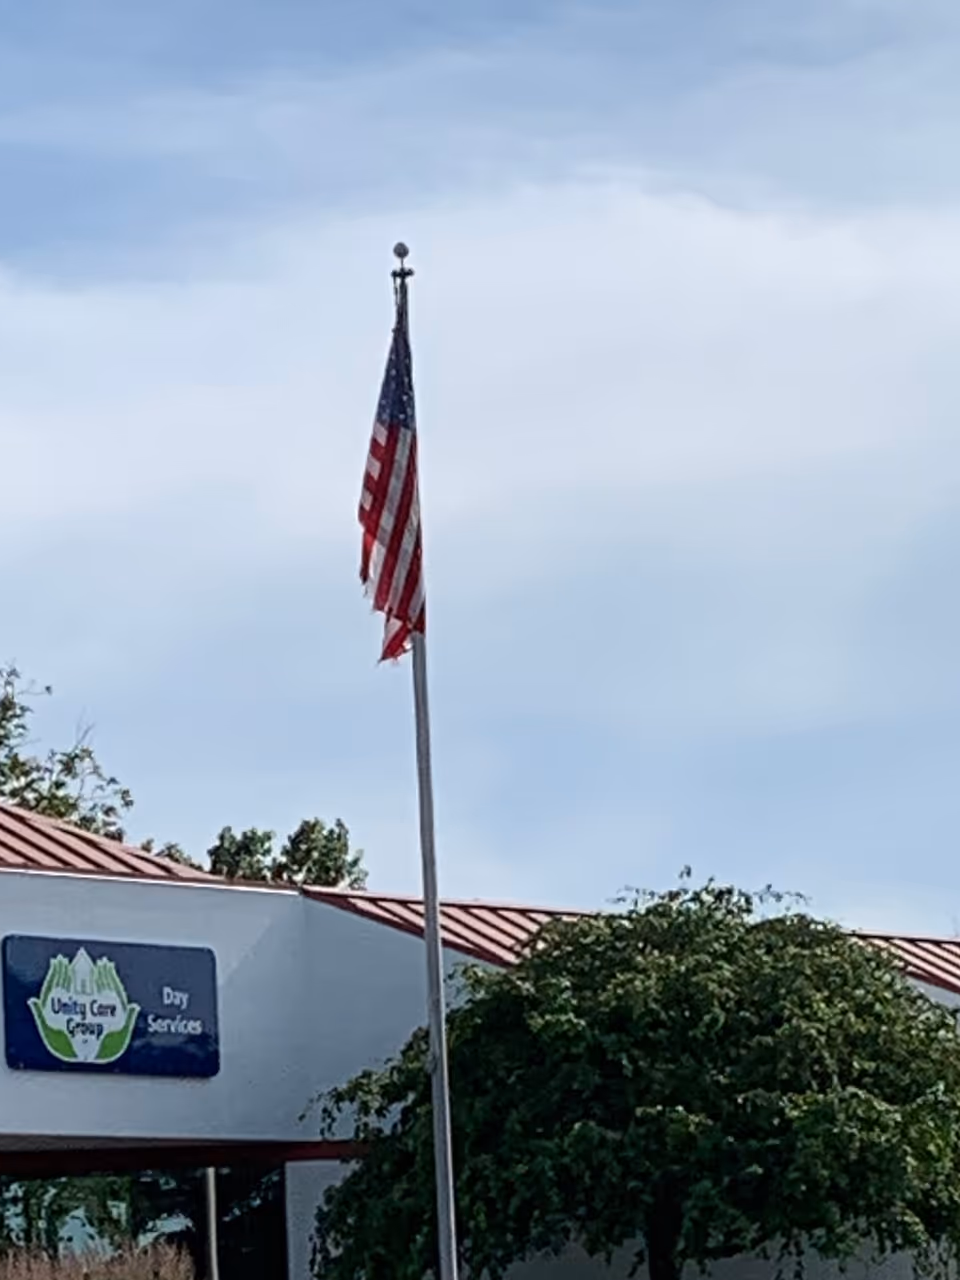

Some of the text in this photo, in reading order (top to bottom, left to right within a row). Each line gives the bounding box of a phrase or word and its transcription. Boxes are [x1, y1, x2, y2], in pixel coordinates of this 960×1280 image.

[51, 997, 117, 1020] Unity Care
[162, 986, 189, 1009] Day
[66, 1019, 104, 1040] Group
[147, 1013, 203, 1035] Services
